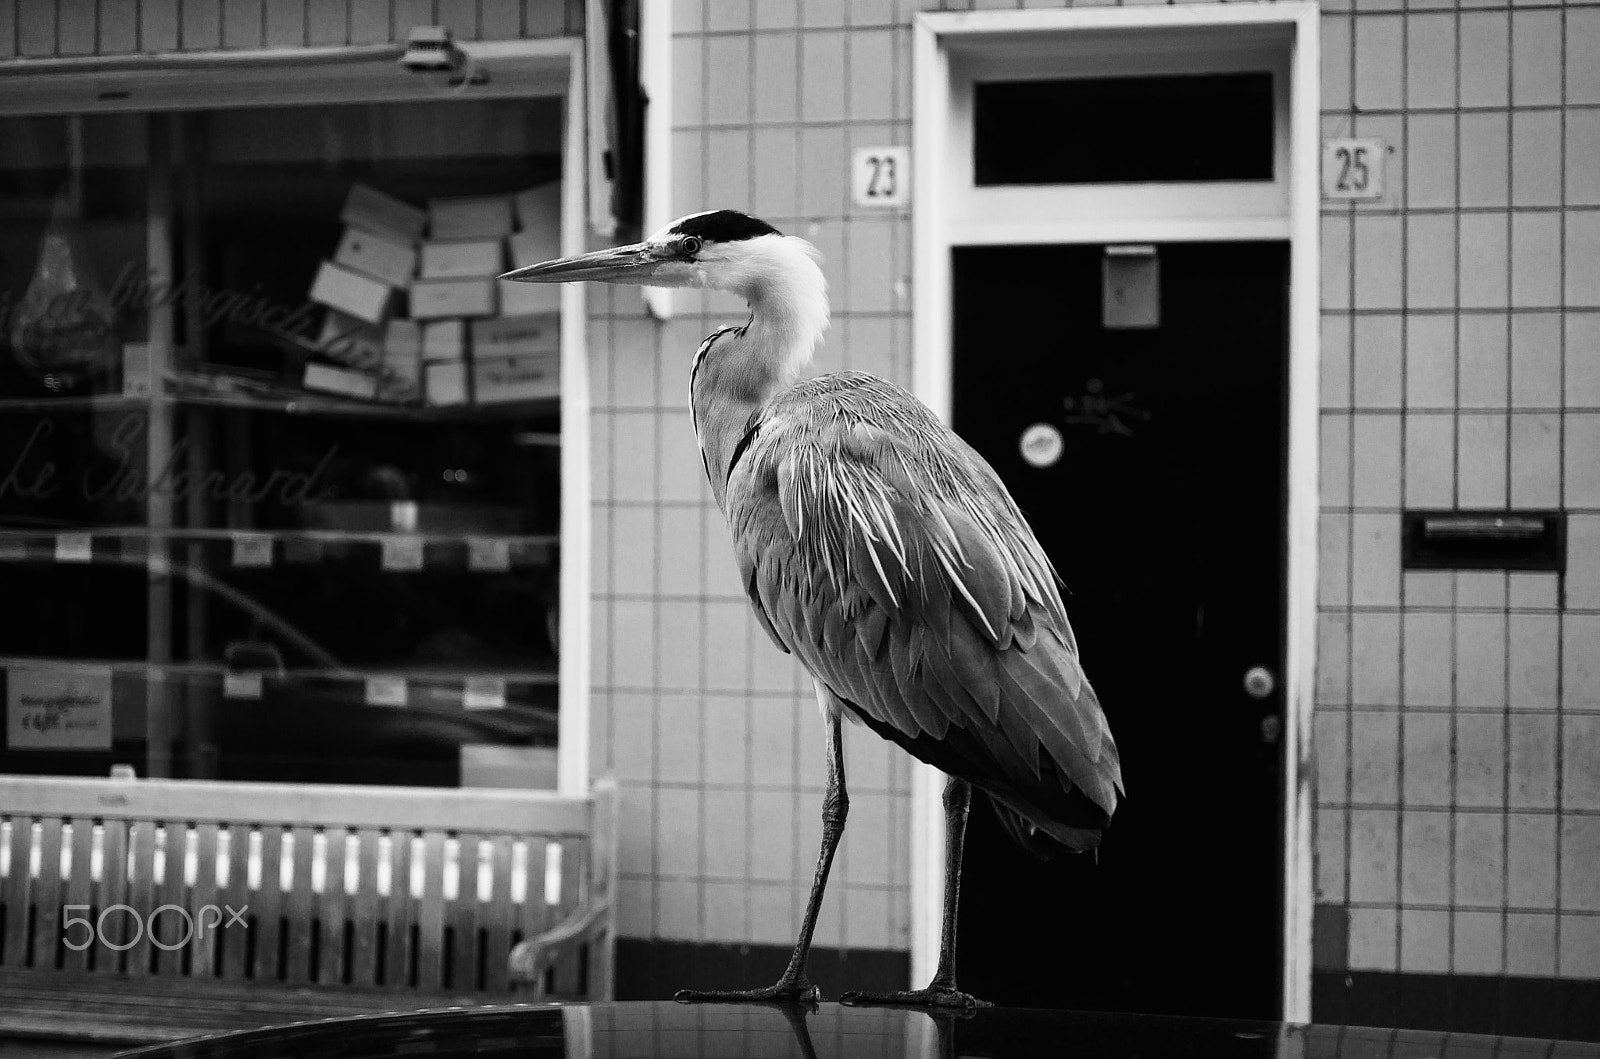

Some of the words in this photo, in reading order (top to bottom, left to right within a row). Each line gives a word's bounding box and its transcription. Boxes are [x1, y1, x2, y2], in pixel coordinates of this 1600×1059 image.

[865, 156, 896, 197] 23
[1336, 146, 1368, 192] 25
[0, 416, 62, 500] Le
